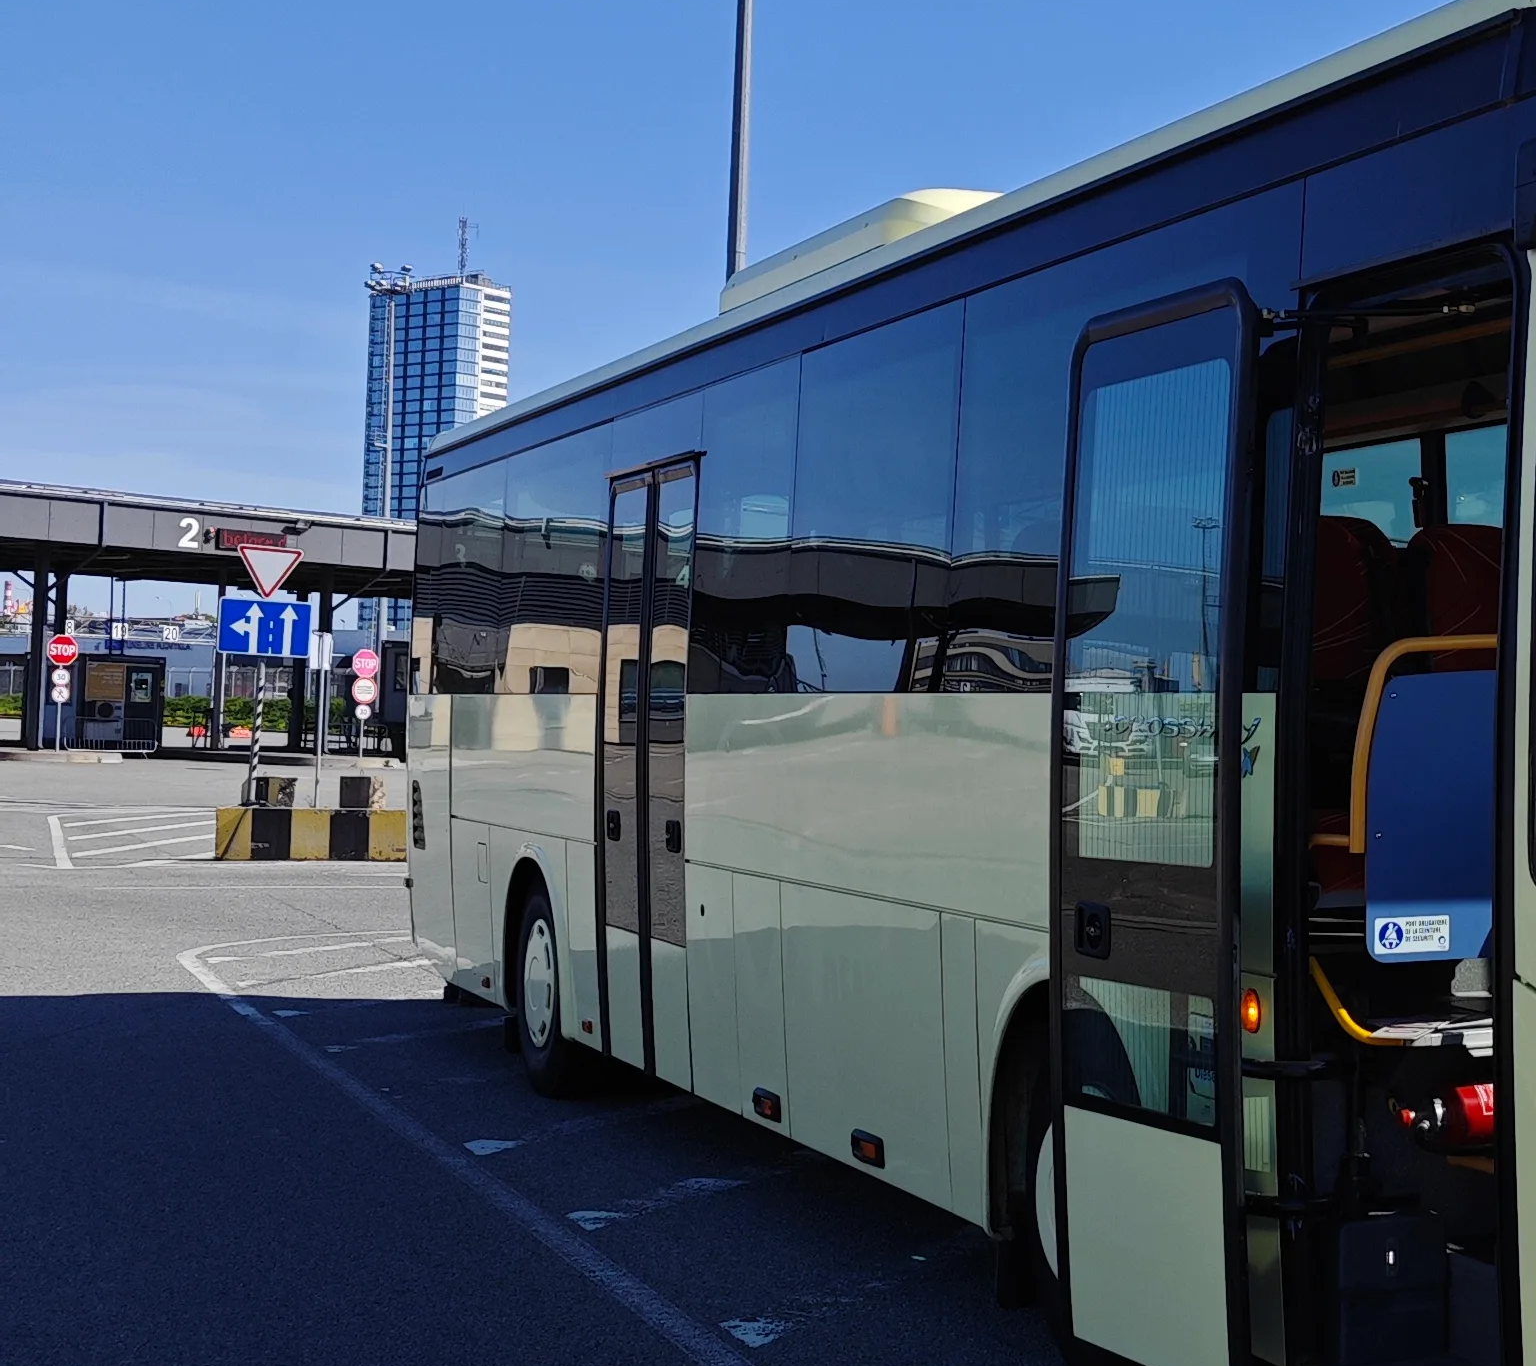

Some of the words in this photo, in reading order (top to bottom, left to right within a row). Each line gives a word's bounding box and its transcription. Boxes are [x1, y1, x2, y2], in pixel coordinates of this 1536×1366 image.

[178, 517, 200, 549] 2
[164, 627, 178, 641] 20
[50, 643, 76, 656] STOP
[355, 657, 377, 669] STOP
[56, 673, 66, 681] 30
